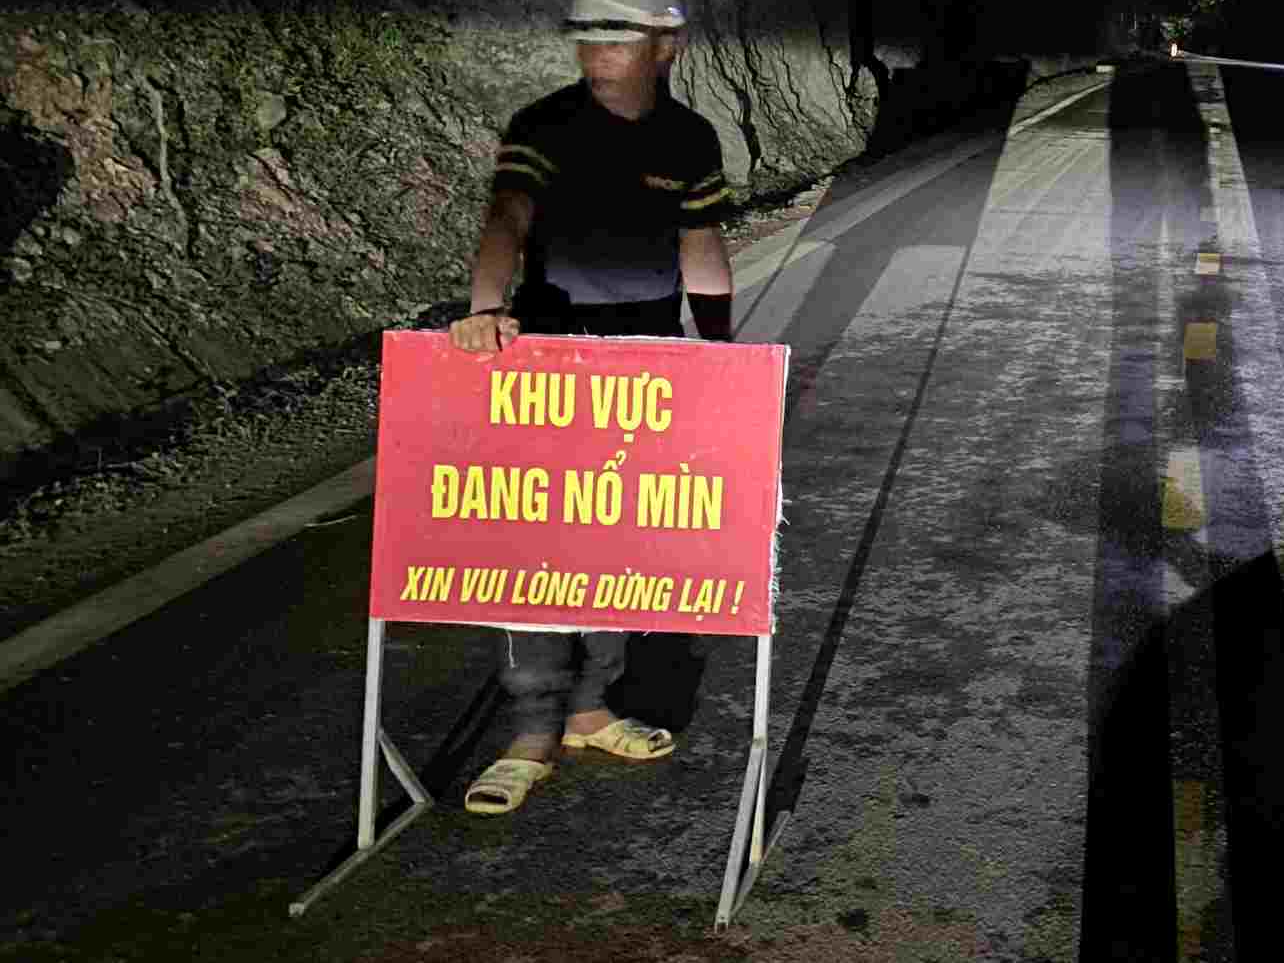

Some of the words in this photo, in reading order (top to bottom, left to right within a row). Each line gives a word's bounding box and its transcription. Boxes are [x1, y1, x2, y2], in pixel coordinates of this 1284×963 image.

[489, 370, 576, 428] KHU
[590, 371, 673, 443] VỰC
[431, 463, 549, 522] ĐANG
[563, 449, 627, 526] NỔ
[637, 462, 724, 530] MÌN
[399, 564, 454, 603] XIN
[460, 568, 508, 605] VUI
[511, 562, 589, 610] LÒNG
[591, 567, 674, 612] DỪNG
[677, 579, 727, 621] LẠI
